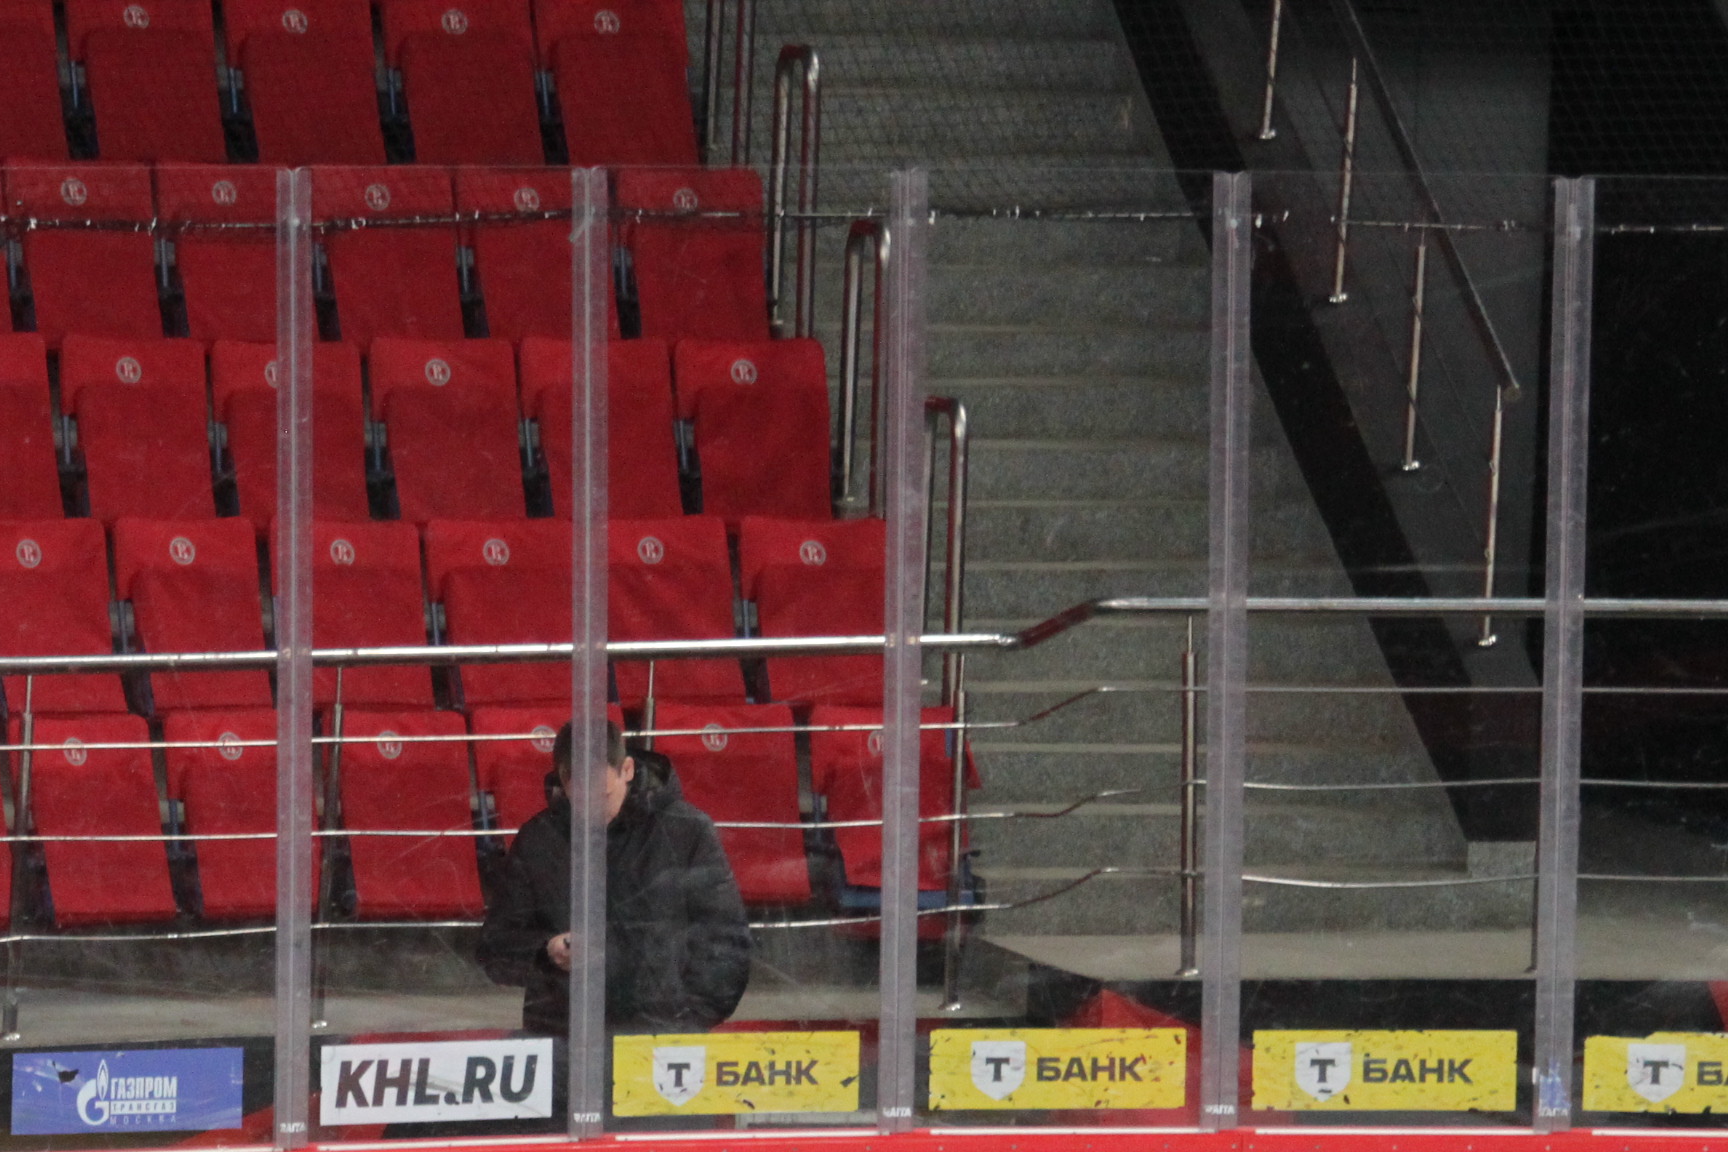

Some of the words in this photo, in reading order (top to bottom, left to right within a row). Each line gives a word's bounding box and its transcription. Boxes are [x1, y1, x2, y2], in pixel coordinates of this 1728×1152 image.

[335, 1053, 538, 1109] KHL.RU
[716, 1059, 819, 1087] БАНК
[1036, 1056, 1143, 1083] БАНК
[1362, 1057, 1473, 1085] БАНК
[110, 1076, 178, 1099] ГАЗПРОМ
